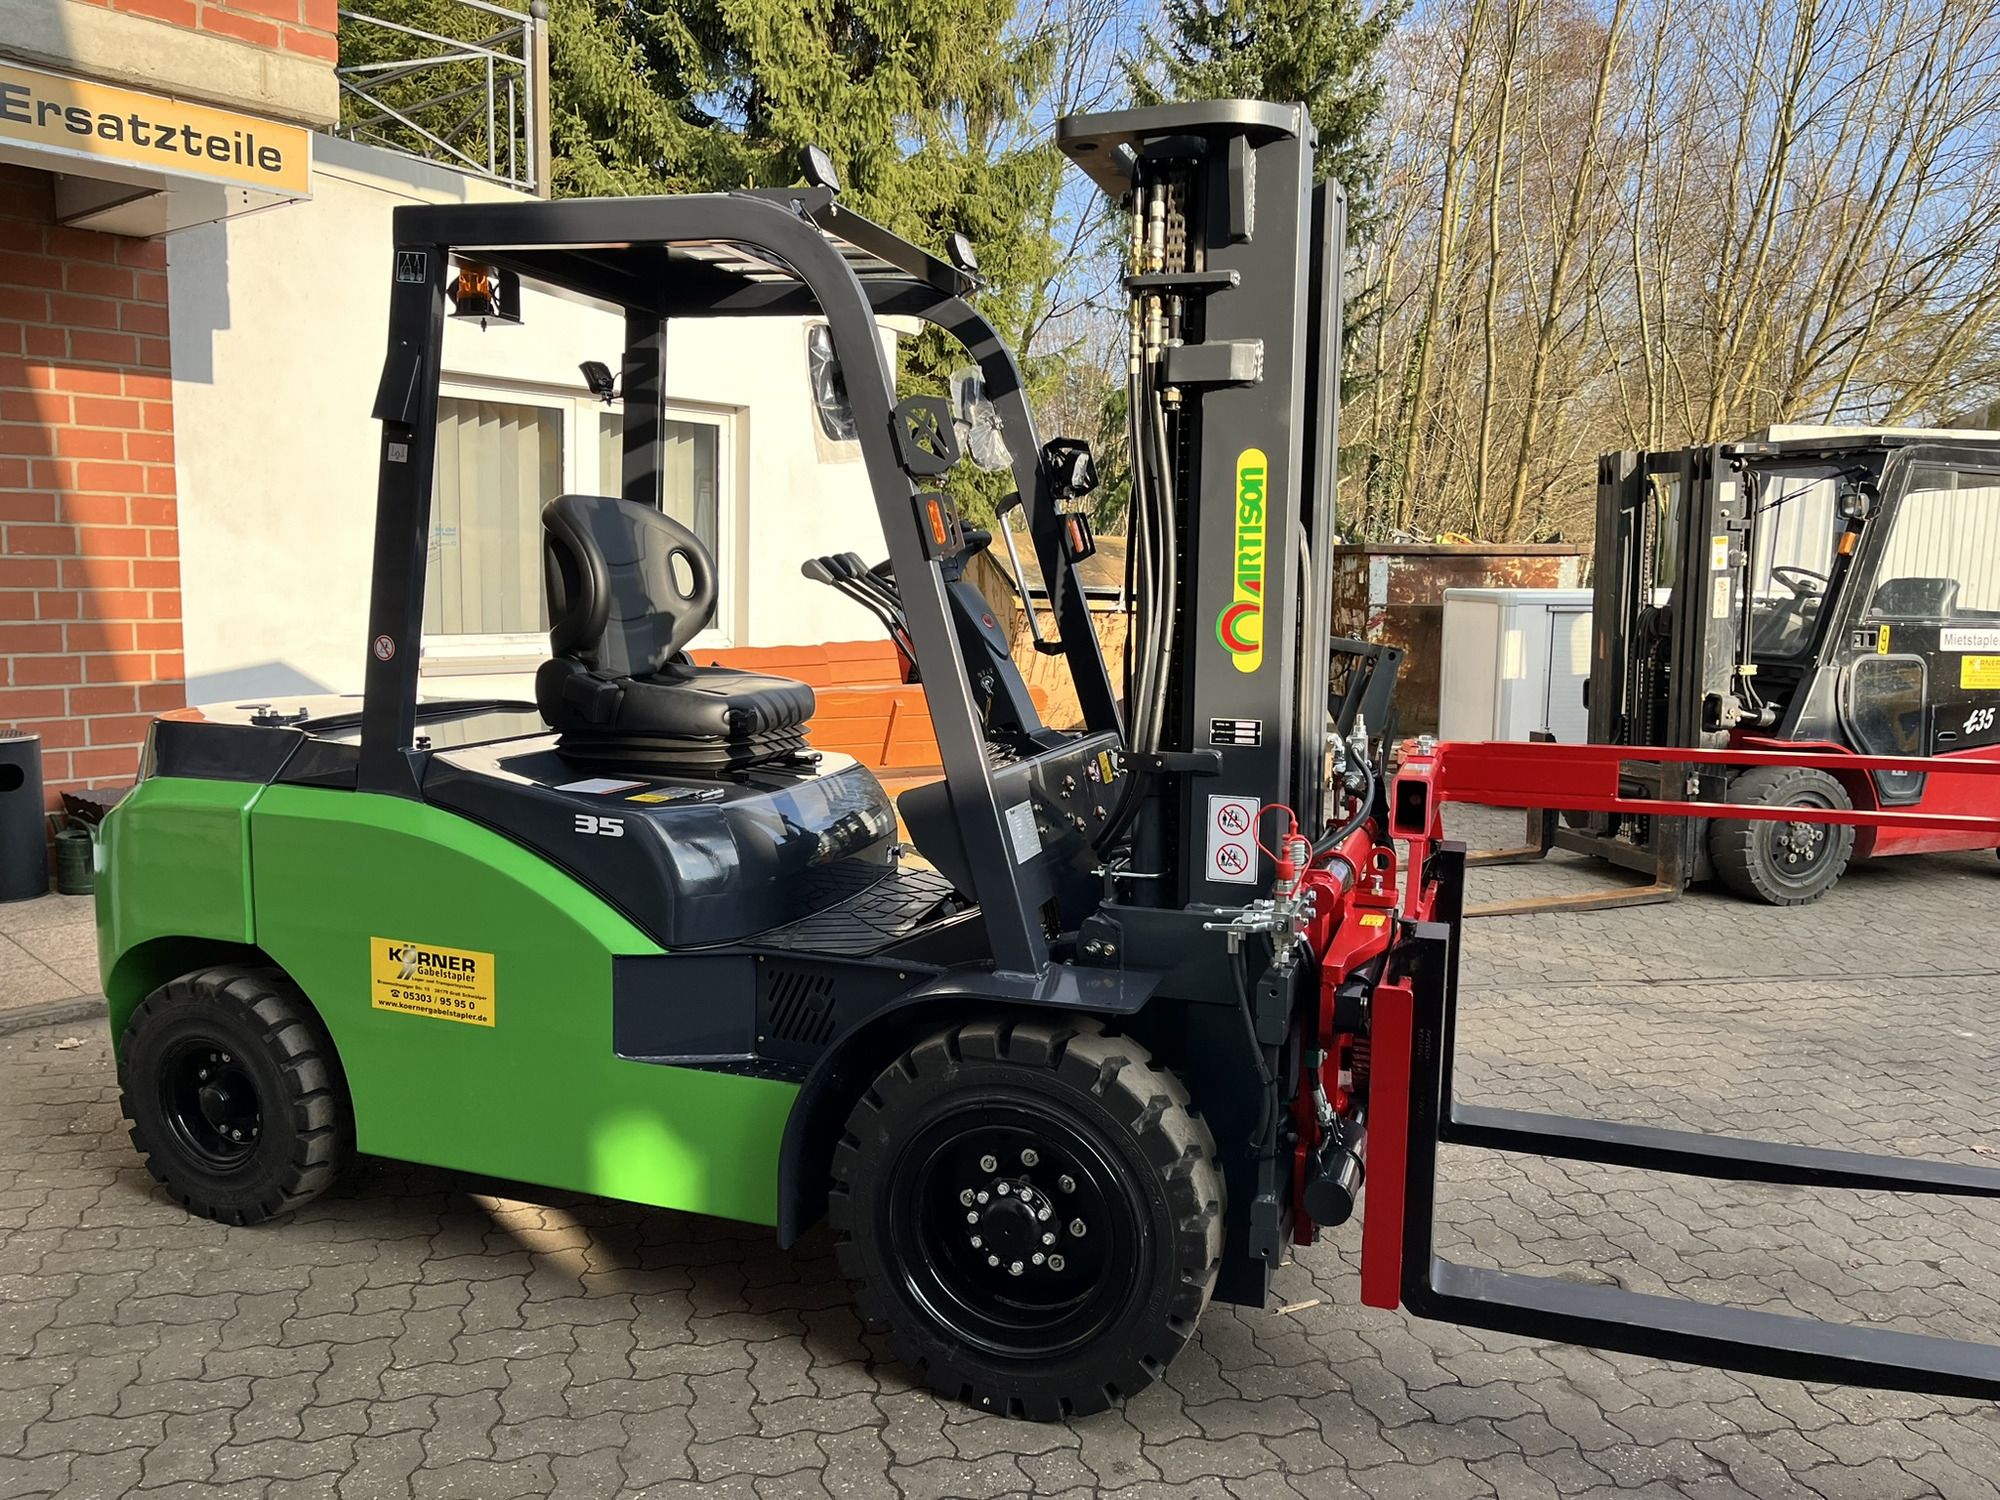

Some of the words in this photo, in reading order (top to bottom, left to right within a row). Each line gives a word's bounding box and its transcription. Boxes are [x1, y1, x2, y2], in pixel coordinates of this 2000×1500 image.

[0, 82, 282, 172] Ersatzteile
[1944, 633, 2000, 648] Mietstaple
[574, 813, 625, 838] 35
[388, 943, 477, 974] KÖRNER
[416, 966, 476, 983] Gabelstapler
[377, 998, 488, 1023] www.koernergabelstapler.de
[403, 990, 432, 1004] 05303
[439, 996, 452, 1008] 95
[453, 998, 467, 1010] 95
[468, 1000, 476, 1011] 0
